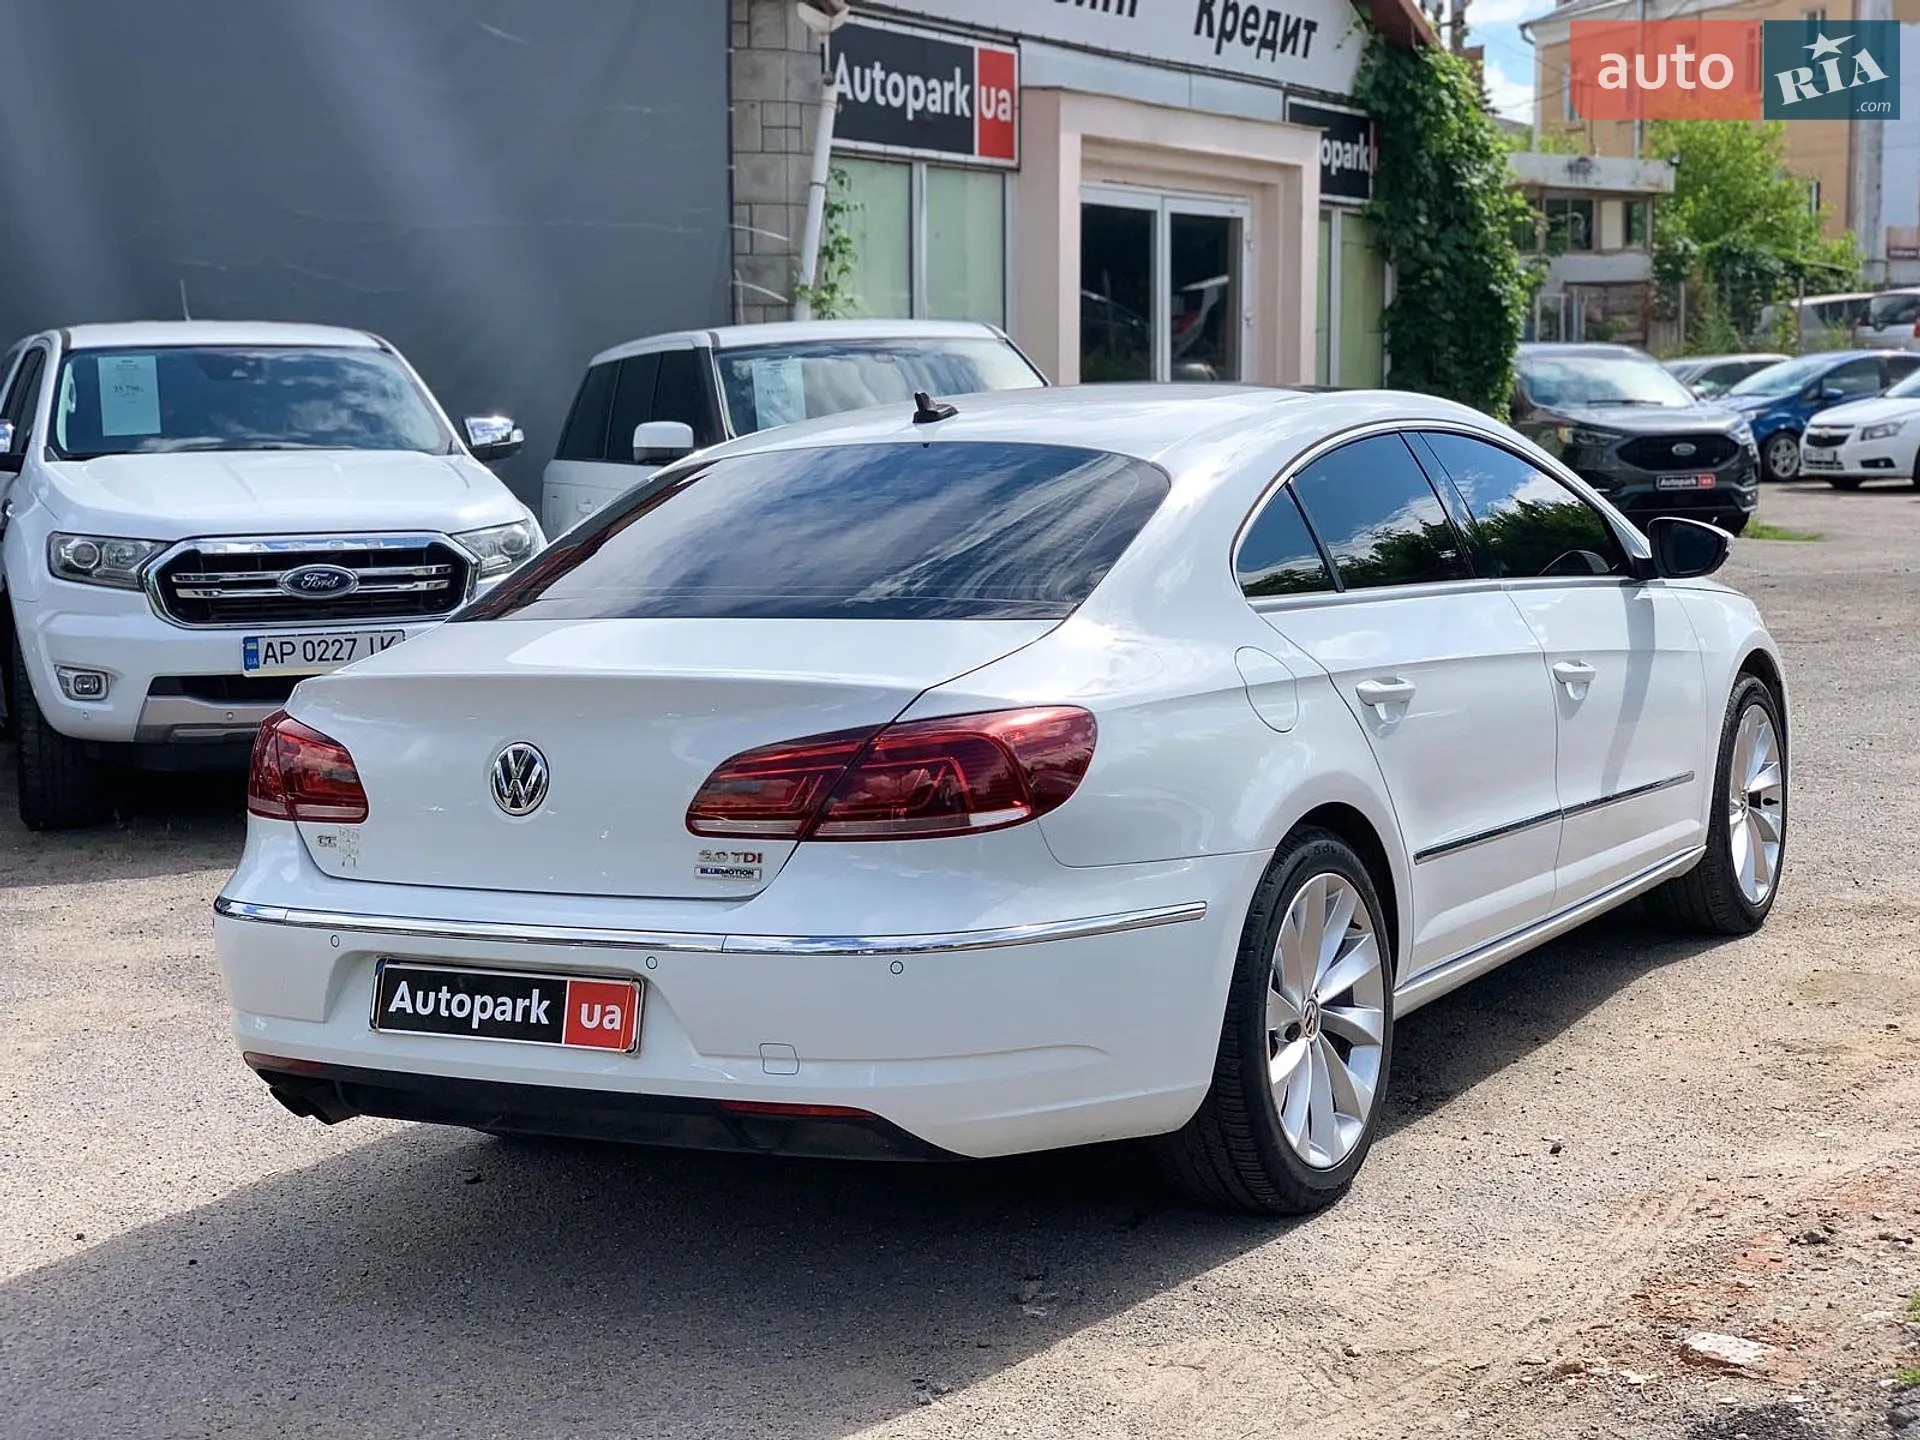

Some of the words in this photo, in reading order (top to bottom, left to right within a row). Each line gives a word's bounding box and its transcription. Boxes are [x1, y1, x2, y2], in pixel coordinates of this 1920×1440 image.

[1194, 0, 1319, 62] Кредит
[835, 52, 971, 121] Autopark
[981, 85, 1012, 123] ua
[1321, 132, 1370, 176] opark
[300, 572, 339, 589] Ford
[263, 641, 296, 664] AP
[302, 638, 357, 662] 0227
[700, 867, 754, 875] BLUEMOTION
[731, 851, 762, 863] TDI
[388, 980, 551, 1030] Autopark
[580, 1002, 622, 1031] ua
